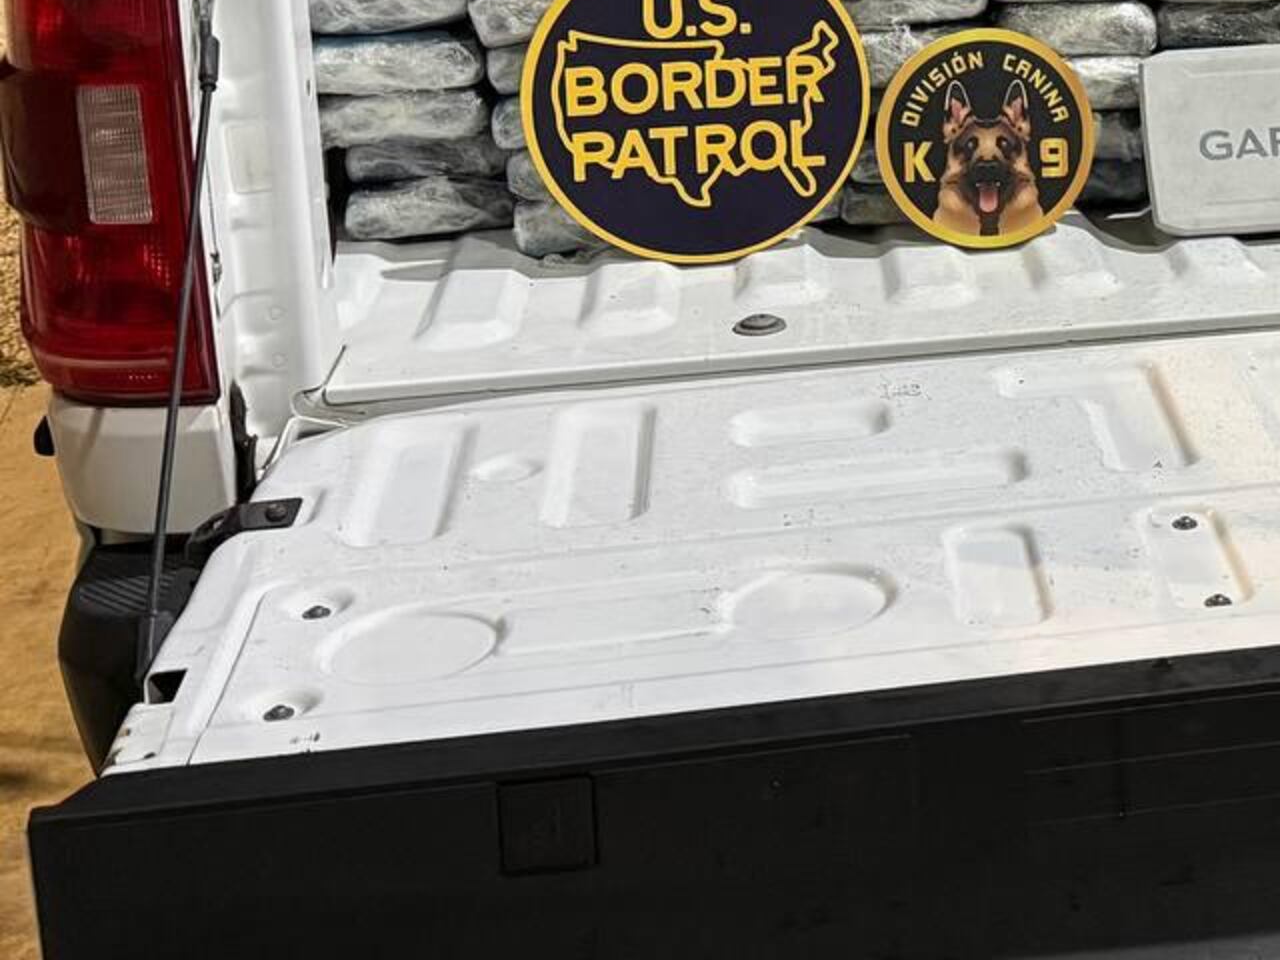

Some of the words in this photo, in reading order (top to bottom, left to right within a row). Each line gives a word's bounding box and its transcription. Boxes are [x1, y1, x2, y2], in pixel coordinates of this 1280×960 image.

[564, 55, 825, 118] BORDER
[901, 50, 984, 128] DIVISIÓN
[1002, 52, 1070, 123] CANINA
[571, 119, 827, 183] PATROL
[903, 141, 936, 183] K
[1039, 137, 1069, 179] 9
